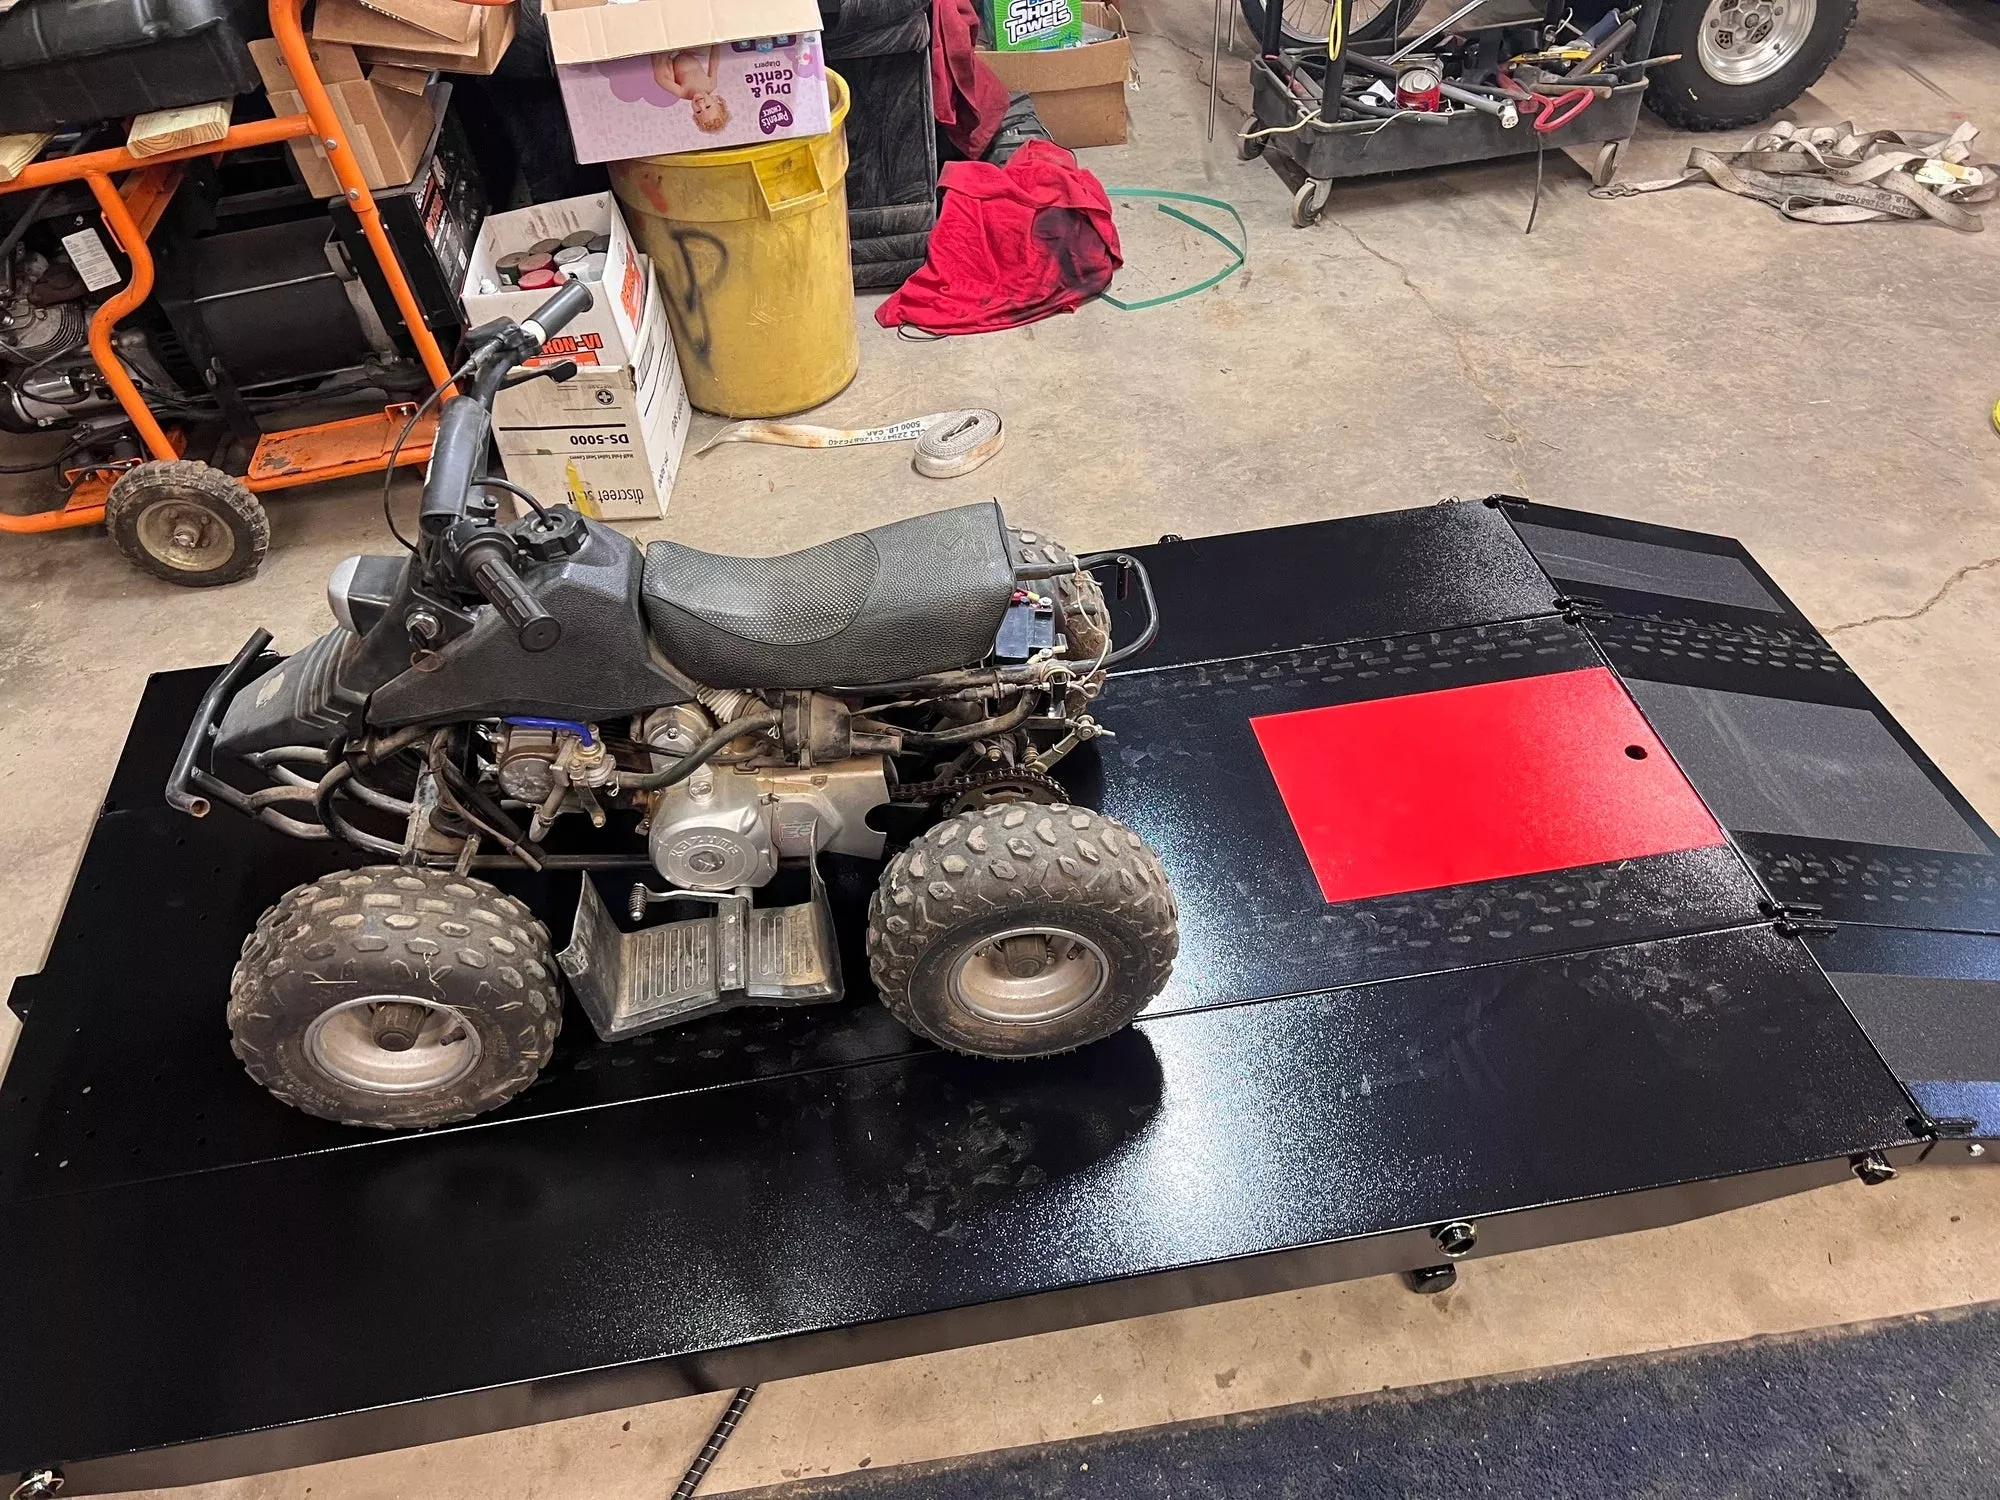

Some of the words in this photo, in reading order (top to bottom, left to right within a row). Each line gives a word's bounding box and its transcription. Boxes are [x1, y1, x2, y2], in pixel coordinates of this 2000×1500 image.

[1009, 0, 1067, 24] SHOP
[1004, 9, 1072, 44] TOWELS
[754, 60, 781, 69] Diapers
[745, 69, 793, 85] Gentle
[751, 87, 760, 98] &
[766, 83, 791, 95] Dry
[761, 110, 789, 129] Parent's
[901, 420, 921, 430] 5000
[570, 434, 629, 445] DS-5000
[598, 488, 644, 504] discreet
